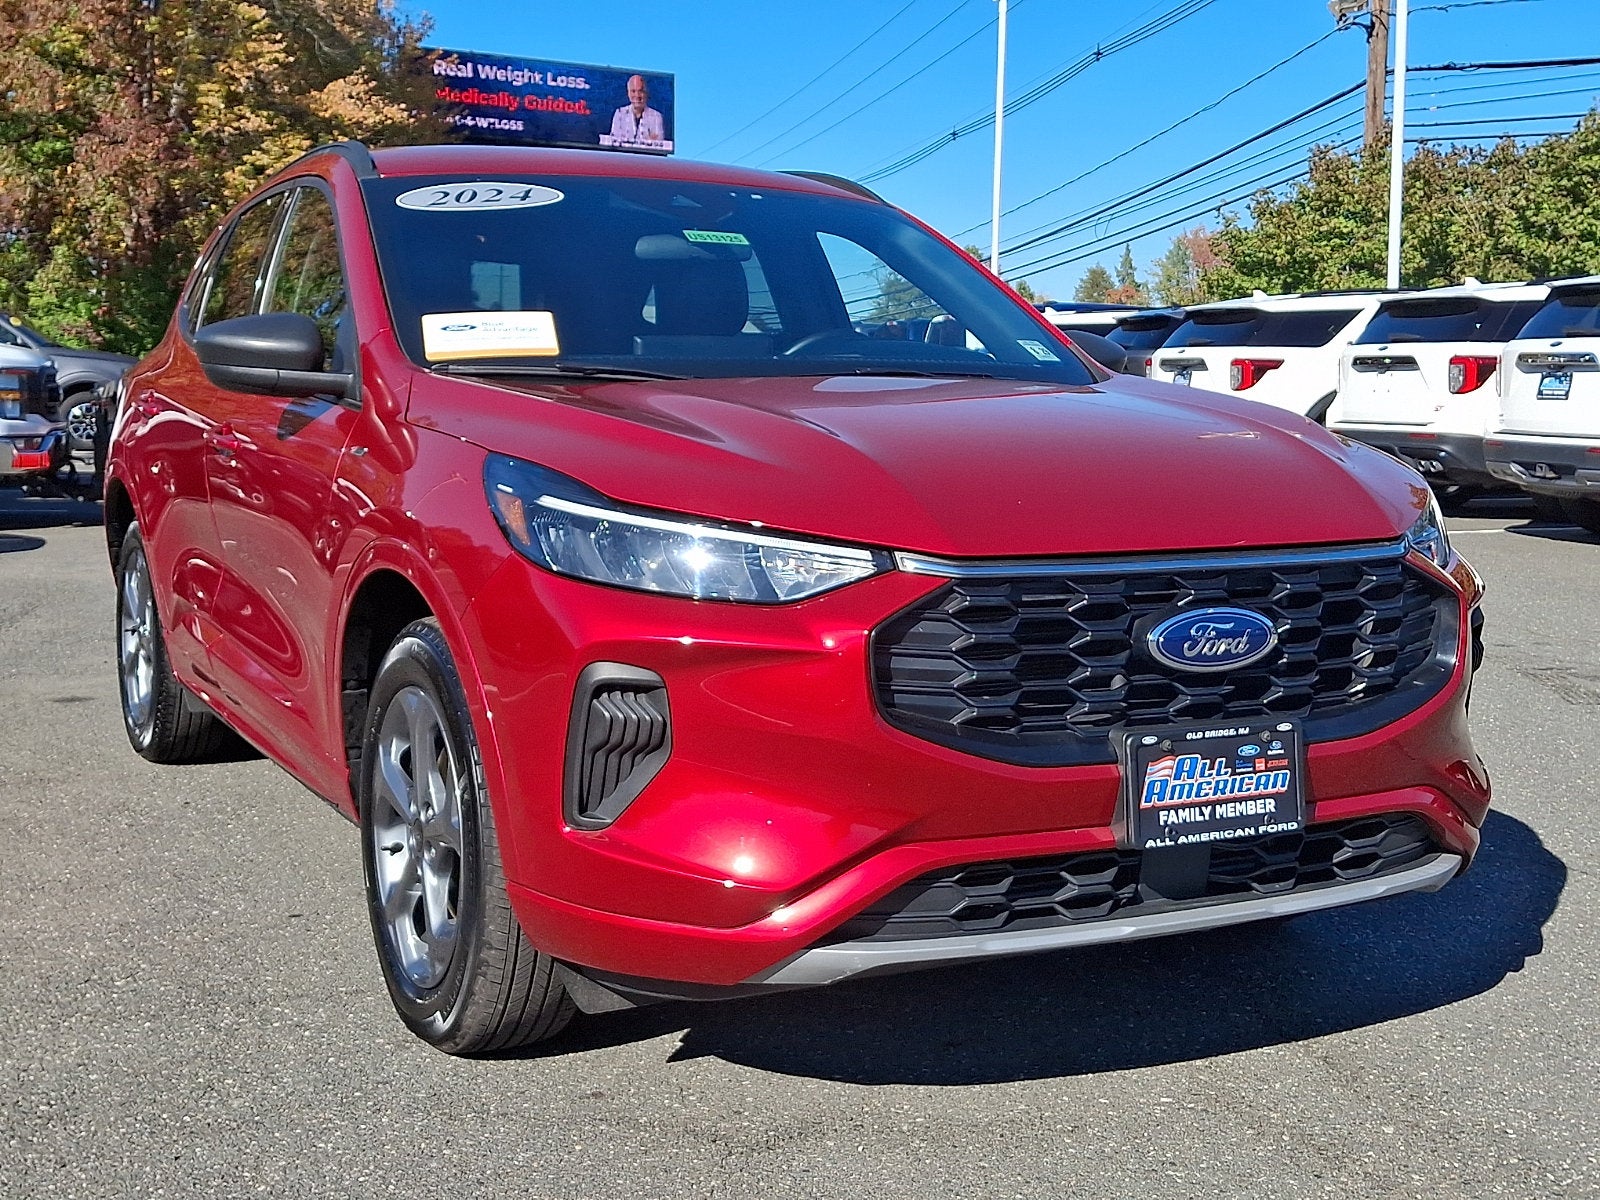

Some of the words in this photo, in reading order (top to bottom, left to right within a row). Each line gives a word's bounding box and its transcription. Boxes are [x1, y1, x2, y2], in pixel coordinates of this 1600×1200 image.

[433, 59, 474, 78] Real
[477, 64, 543, 87] Weight
[547, 72, 592, 90] Loss.
[524, 95, 592, 115] Guided.
[428, 188, 534, 206] 2024
[1183, 622, 1252, 657] Ford
[1186, 732, 1204, 740] OLD
[1238, 727, 1250, 735] NJ
[1141, 770, 1291, 807] AMERICAN
[1159, 805, 1213, 826] FAMILY
[1215, 798, 1277, 820] MEMBER
[1145, 837, 1175, 849] ALL
[1177, 827, 1256, 845] AMERICAN
[1258, 821, 1299, 835] FORD
